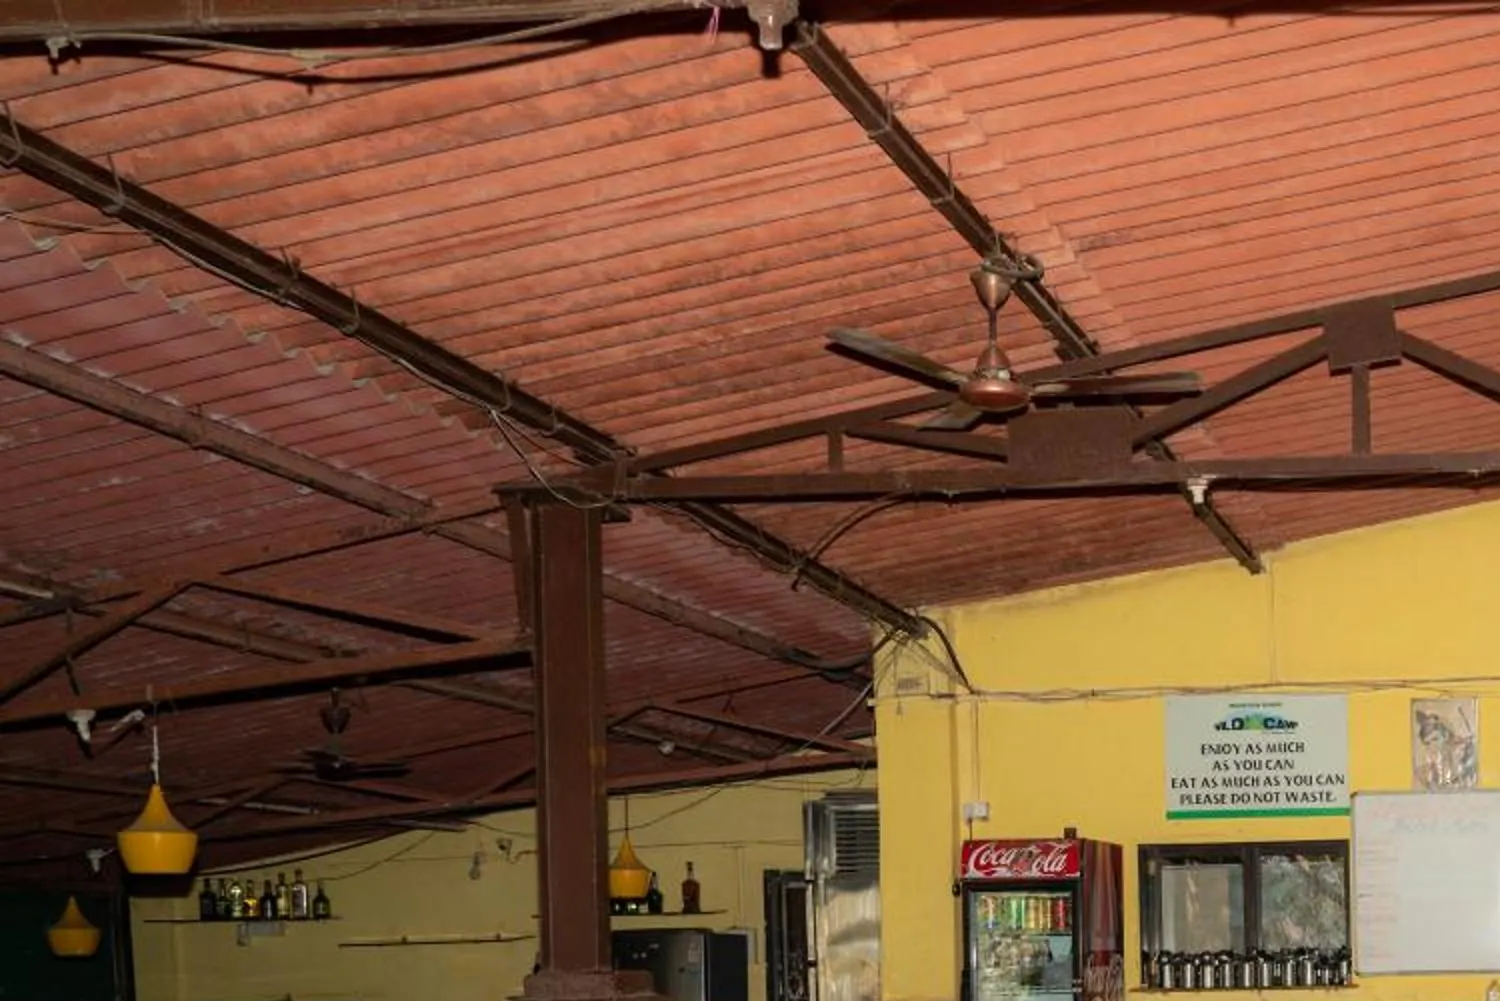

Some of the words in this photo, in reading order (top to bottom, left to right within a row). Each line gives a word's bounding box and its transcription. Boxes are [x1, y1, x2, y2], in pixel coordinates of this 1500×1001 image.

[1245, 743, 1263, 755] AS
[1266, 742, 1305, 753] MUCH
[1212, 760, 1229, 771] AS
[1233, 760, 1262, 770] YOU
[1265, 759, 1294, 770] CAN
[1171, 778, 1196, 789] EAT
[1201, 777, 1218, 789] AS
[1221, 776, 1259, 788] MUCH
[1263, 775, 1281, 787] AS
[1284, 774, 1313, 786] YOU
[1315, 774, 1345, 786] CAN
[1180, 793, 1227, 805] PLEASE
[1231, 793, 1251, 804] DO
[1253, 792, 1281, 803] NOT
[967, 841, 1075, 877] Cocaola
